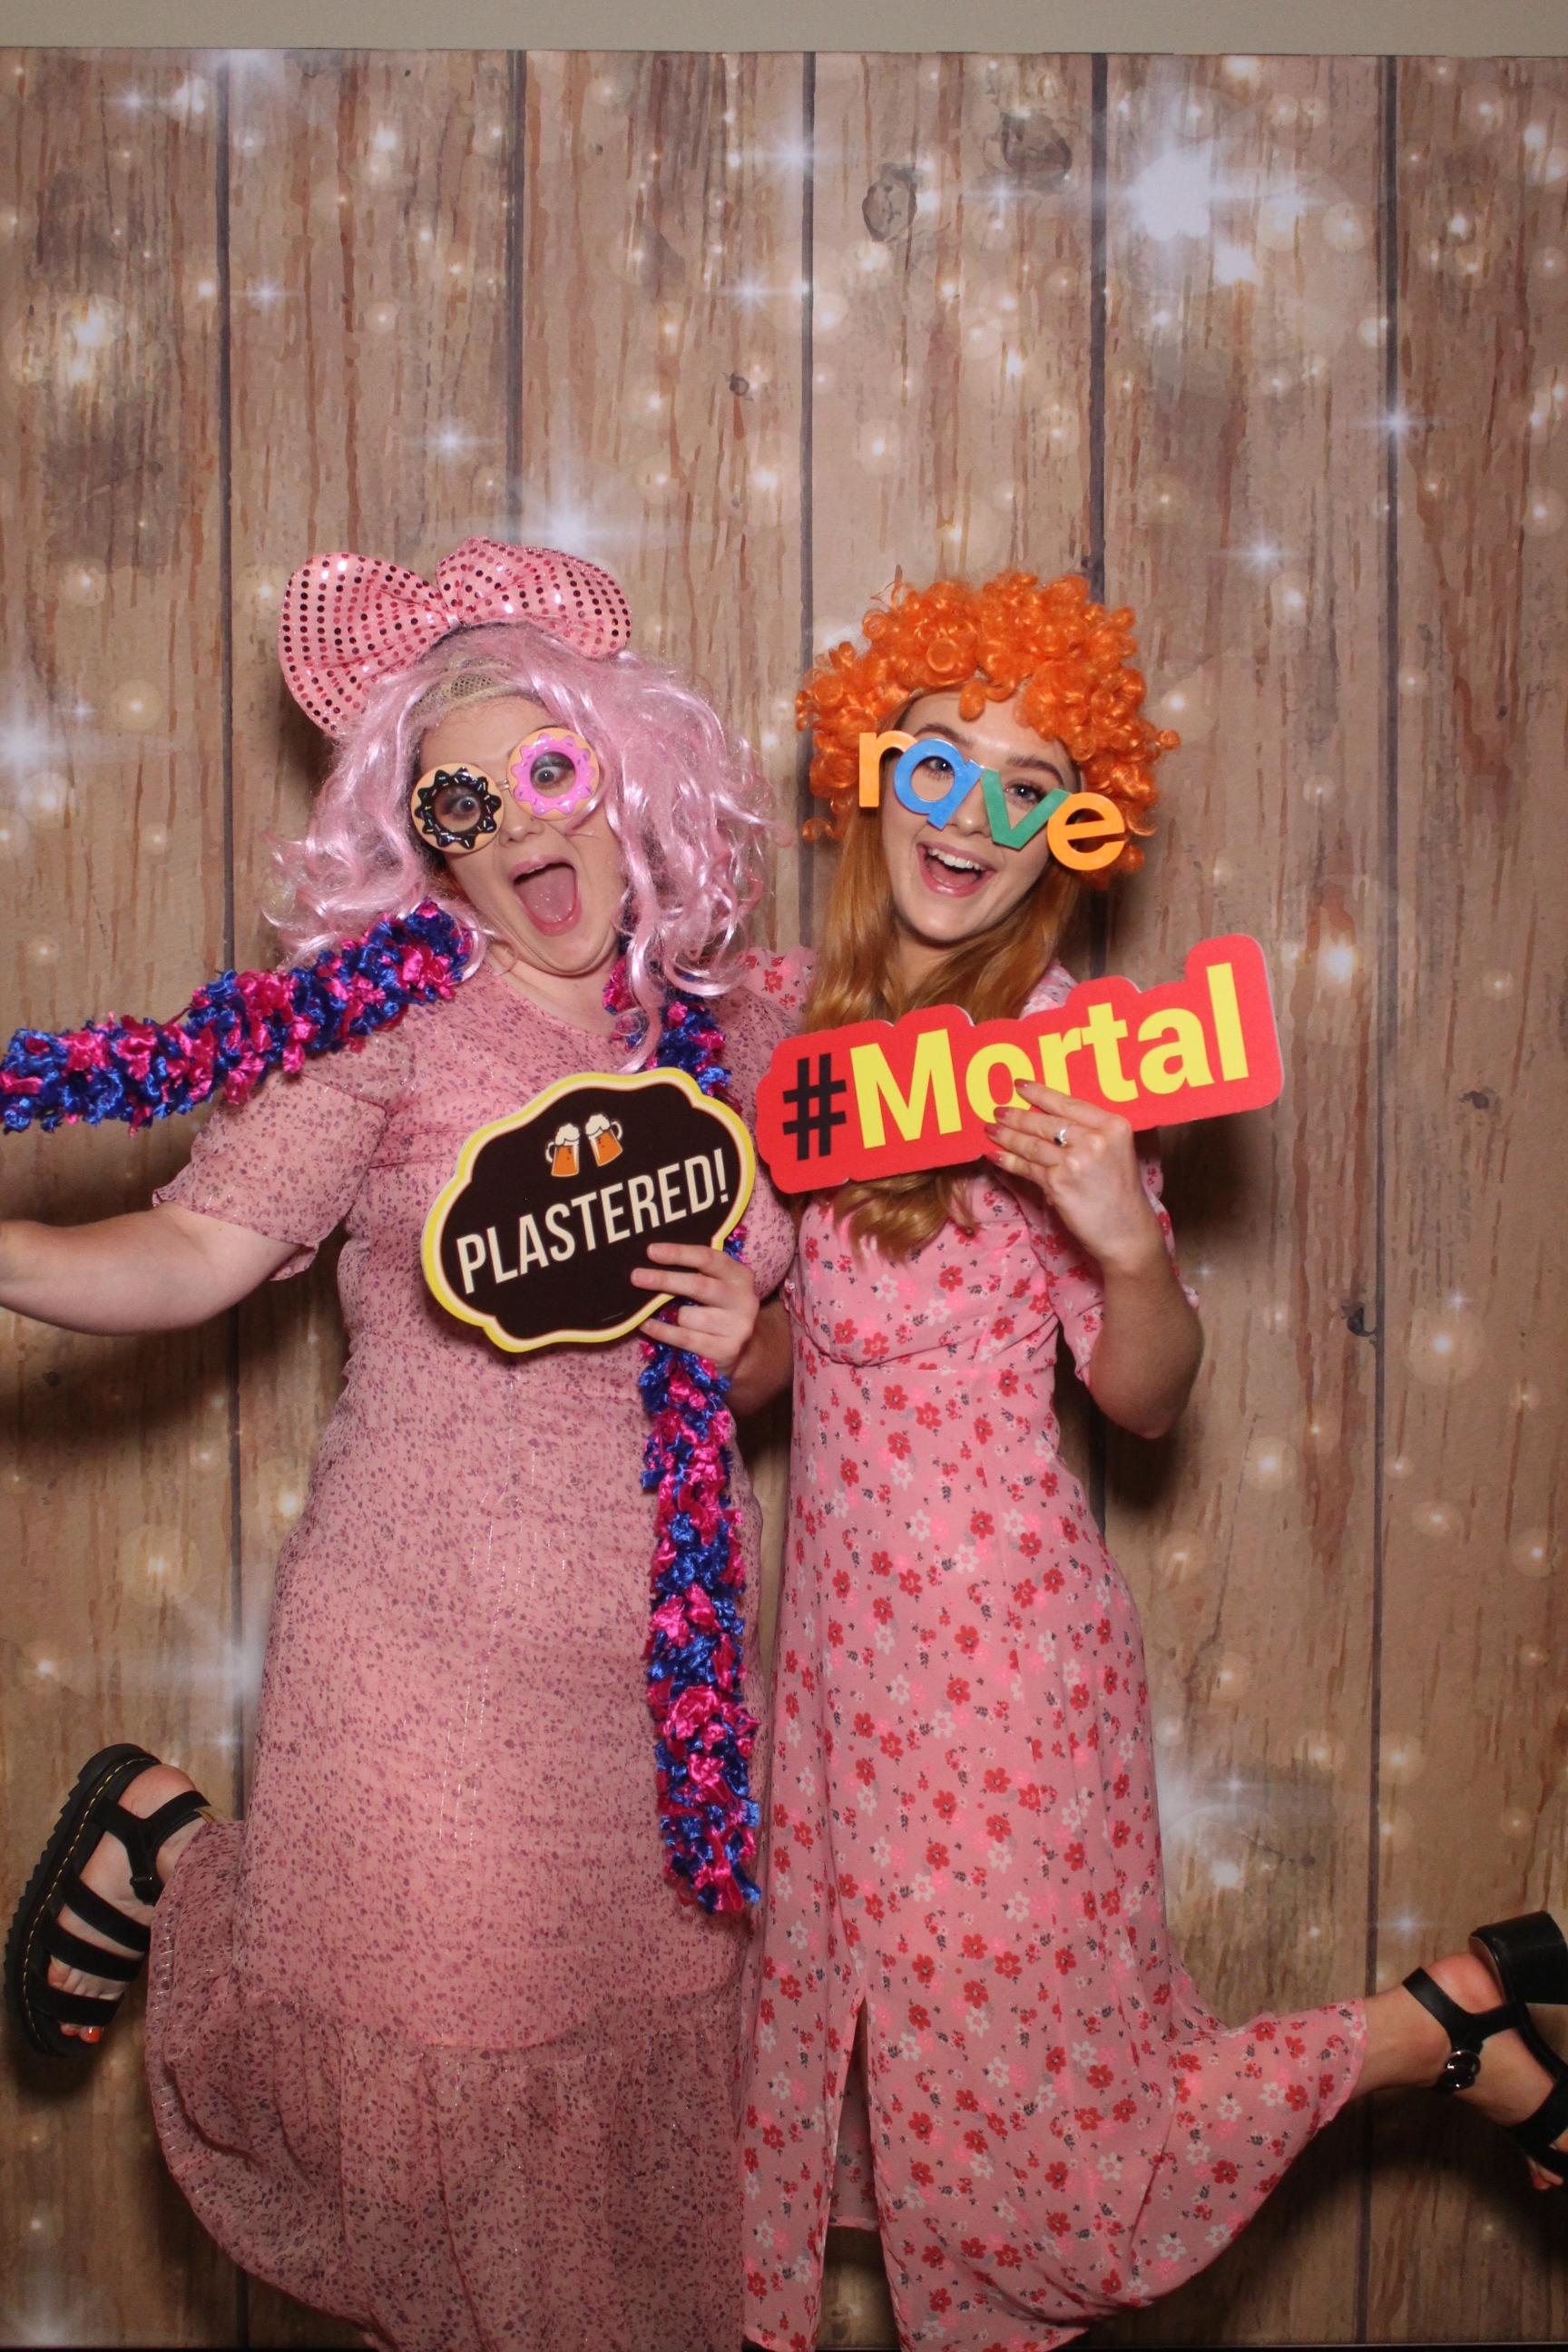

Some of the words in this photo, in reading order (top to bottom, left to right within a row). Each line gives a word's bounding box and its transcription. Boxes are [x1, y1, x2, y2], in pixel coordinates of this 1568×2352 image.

[859, 730, 1125, 870] rave
[783, 962, 1249, 1161] #Mortal
[456, 1148, 729, 1295] PLASTERED!
